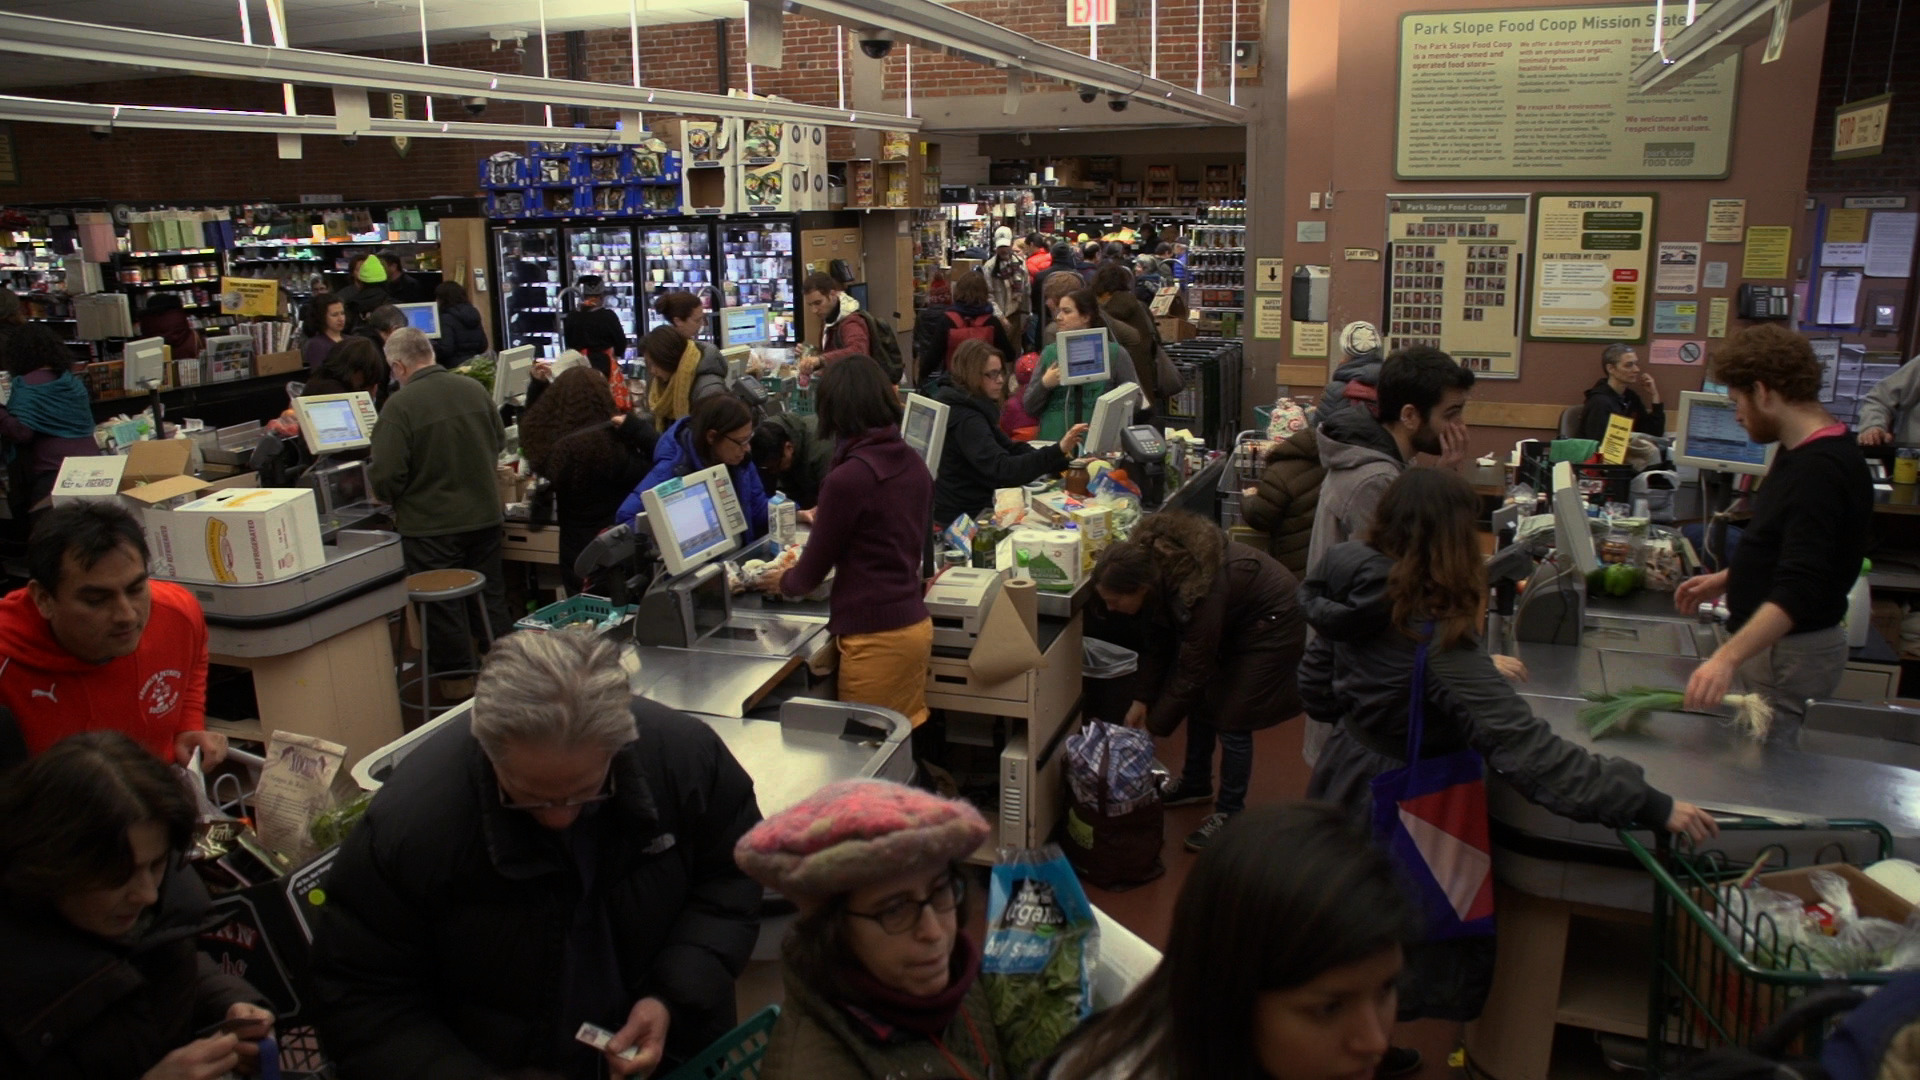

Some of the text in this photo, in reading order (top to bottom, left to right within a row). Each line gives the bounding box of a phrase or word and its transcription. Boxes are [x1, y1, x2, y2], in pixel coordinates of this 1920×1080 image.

[1414, 13, 1687, 37] Park Slope Food Coop Mission Sate
[1414, 41, 1512, 51] The Park Slope Food Coop
[1489, 50, 1504, 58] and
[1412, 62, 1446, 70] operated
[1643, 158, 1693, 167] FOOD COOP
[1406, 203, 1508, 212] Park Slope Food Coop Staff
[1568, 200, 1624, 209] RETURN POLICY
[247, 519, 262, 570] REFRIGERATED
